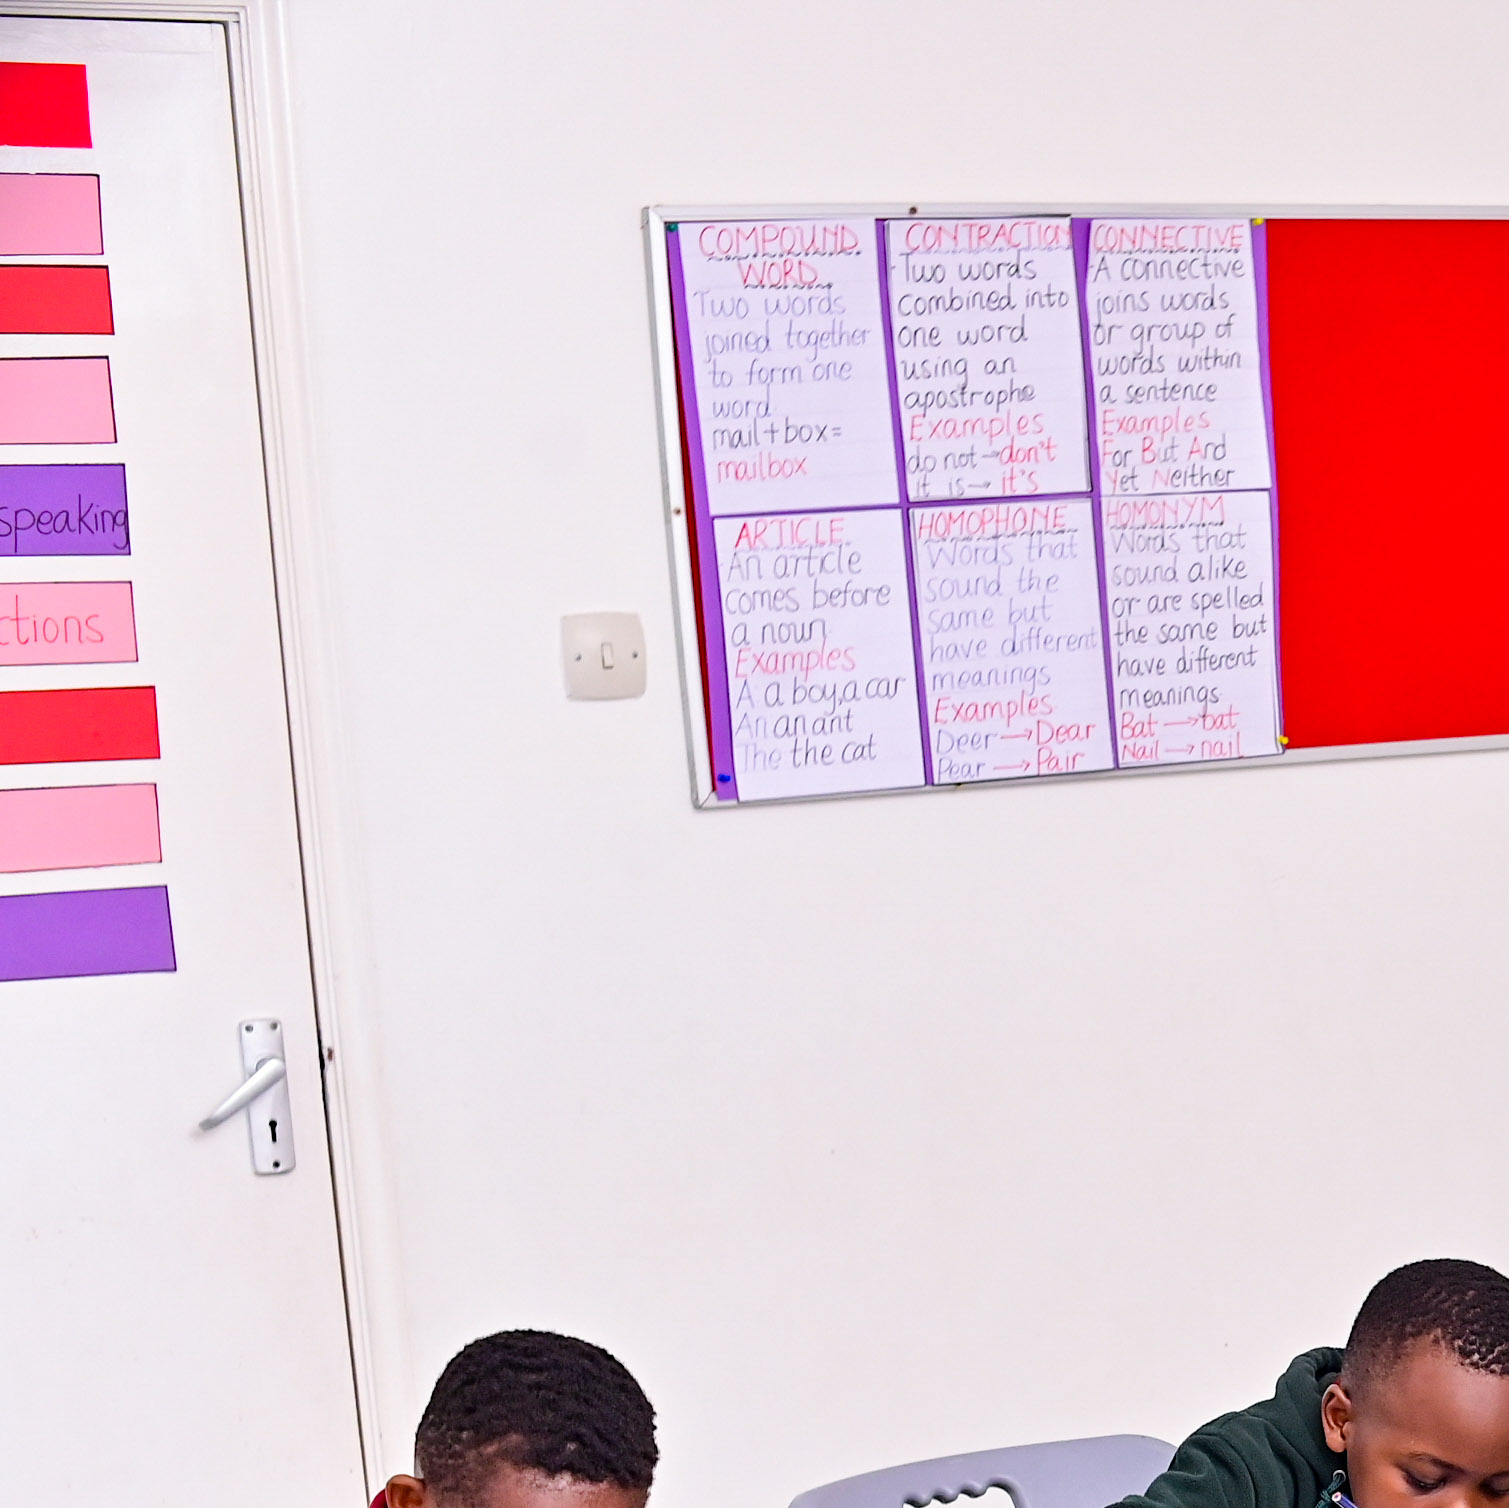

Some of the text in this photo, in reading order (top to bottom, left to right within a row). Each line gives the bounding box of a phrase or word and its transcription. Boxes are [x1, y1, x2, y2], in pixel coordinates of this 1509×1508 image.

[699, 223, 858, 256] COMPOUND
[905, 222, 1070, 253] CONTRACTION
[1093, 223, 1243, 252] CONNECTIVE
[737, 259, 818, 288] WORD
[959, 256, 1037, 282] words
[1120, 256, 1246, 279] connective
[764, 294, 847, 316] words
[898, 288, 1069, 318] combined into
[1094, 289, 1230, 318] joins words
[785, 324, 871, 358] together
[957, 321, 1028, 345] word
[1132, 322, 1206, 357] group
[903, 357, 968, 390] using
[1099, 350, 1242, 375] words within
[904, 381, 1037, 417] apostrophe
[1126, 381, 1219, 403] sentence
[911, 414, 1043, 442] Examples
[1102, 410, 1210, 437] Examples
[1102, 448, 1132, 468] For
[1143, 442, 1177, 464] But
[717, 455, 808, 483] mailbox
[1152, 467, 1235, 491] Neither
[918, 504, 1066, 538] HOMOPHONE
[1105, 494, 1224, 527] HOMONYM
[735, 518, 845, 549] ARTICLE
[1189, 528, 1248, 550] that
[778, 548, 862, 578] article
[1112, 559, 1248, 585] sound alike
[725, 583, 891, 615] comes before
[1191, 588, 1264, 615] spelled
[1160, 615, 1268, 641] same but
[1117, 647, 1258, 677] have different
[1120, 684, 1220, 710] meanings
[1036, 720, 1096, 746] Dear
[1120, 715, 1158, 740] Bat
[1037, 747, 1085, 774] Pair
[1121, 740, 1160, 762] Nail
